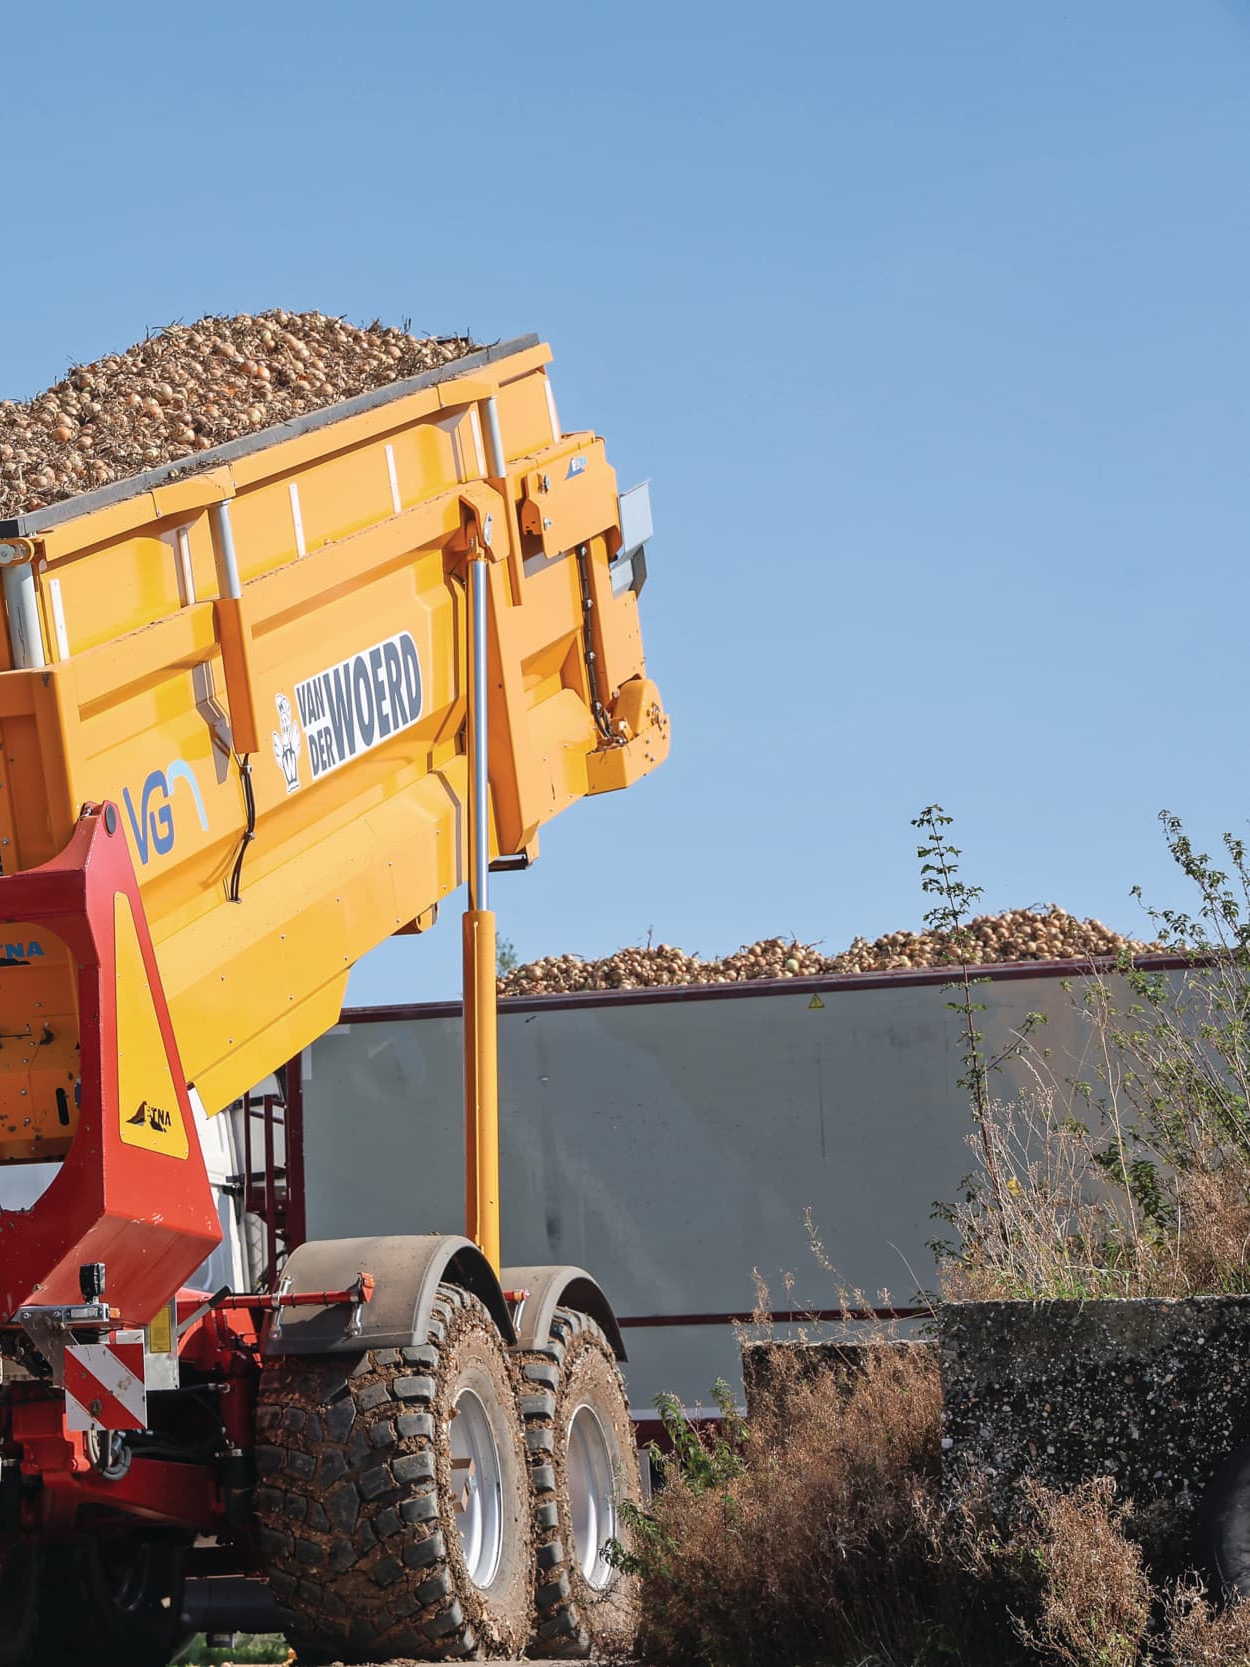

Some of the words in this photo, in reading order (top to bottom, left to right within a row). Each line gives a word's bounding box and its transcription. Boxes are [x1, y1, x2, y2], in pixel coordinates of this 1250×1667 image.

[296, 676, 326, 727] VAN
[322, 633, 422, 762] WOERD
[308, 725, 336, 777] DER
